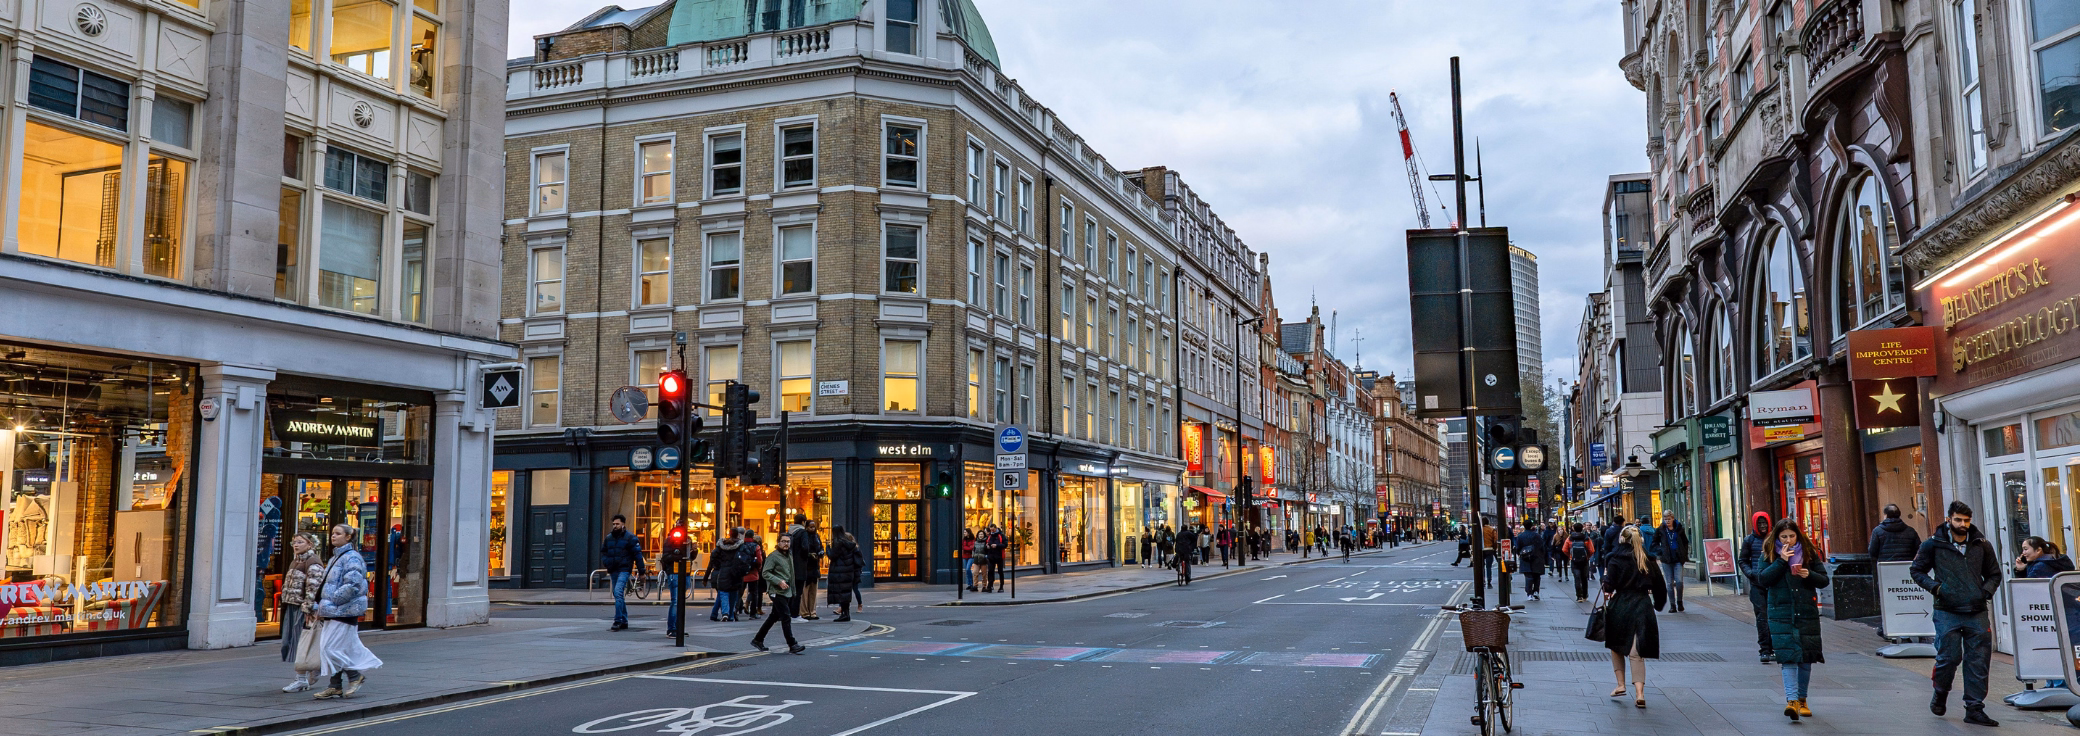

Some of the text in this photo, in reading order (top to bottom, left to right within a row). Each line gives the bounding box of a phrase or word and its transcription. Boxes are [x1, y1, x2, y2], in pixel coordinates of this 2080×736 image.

[1508, 245, 1525, 257] CENTRE
[1940, 257, 2049, 332] DIANETICS &
[1952, 293, 2080, 373] SCIENTOLOGY
[1881, 341, 1902, 349] LIFE
[1856, 348, 1929, 359] IMPROVEMENT
[1873, 357, 1913, 366] CENTRE
[1981, 353, 2031, 379] IMPROVEMENT
[2031, 345, 2063, 365] CENTRE
[1756, 404, 1808, 414] Ryman
[286, 420, 374, 438] ANDREW MARTIN
[1704, 422, 1727, 430] HOLLAND
[2055, 415, 2073, 447] 68
[879, 444, 932, 455] west elm
[141, 473, 157, 481] elm
[63, 580, 152, 603] MARTIN
[2029, 603, 2050, 611] FREE
[2021, 614, 2054, 622] SHOWI
[2030, 625, 2049, 633] THE
